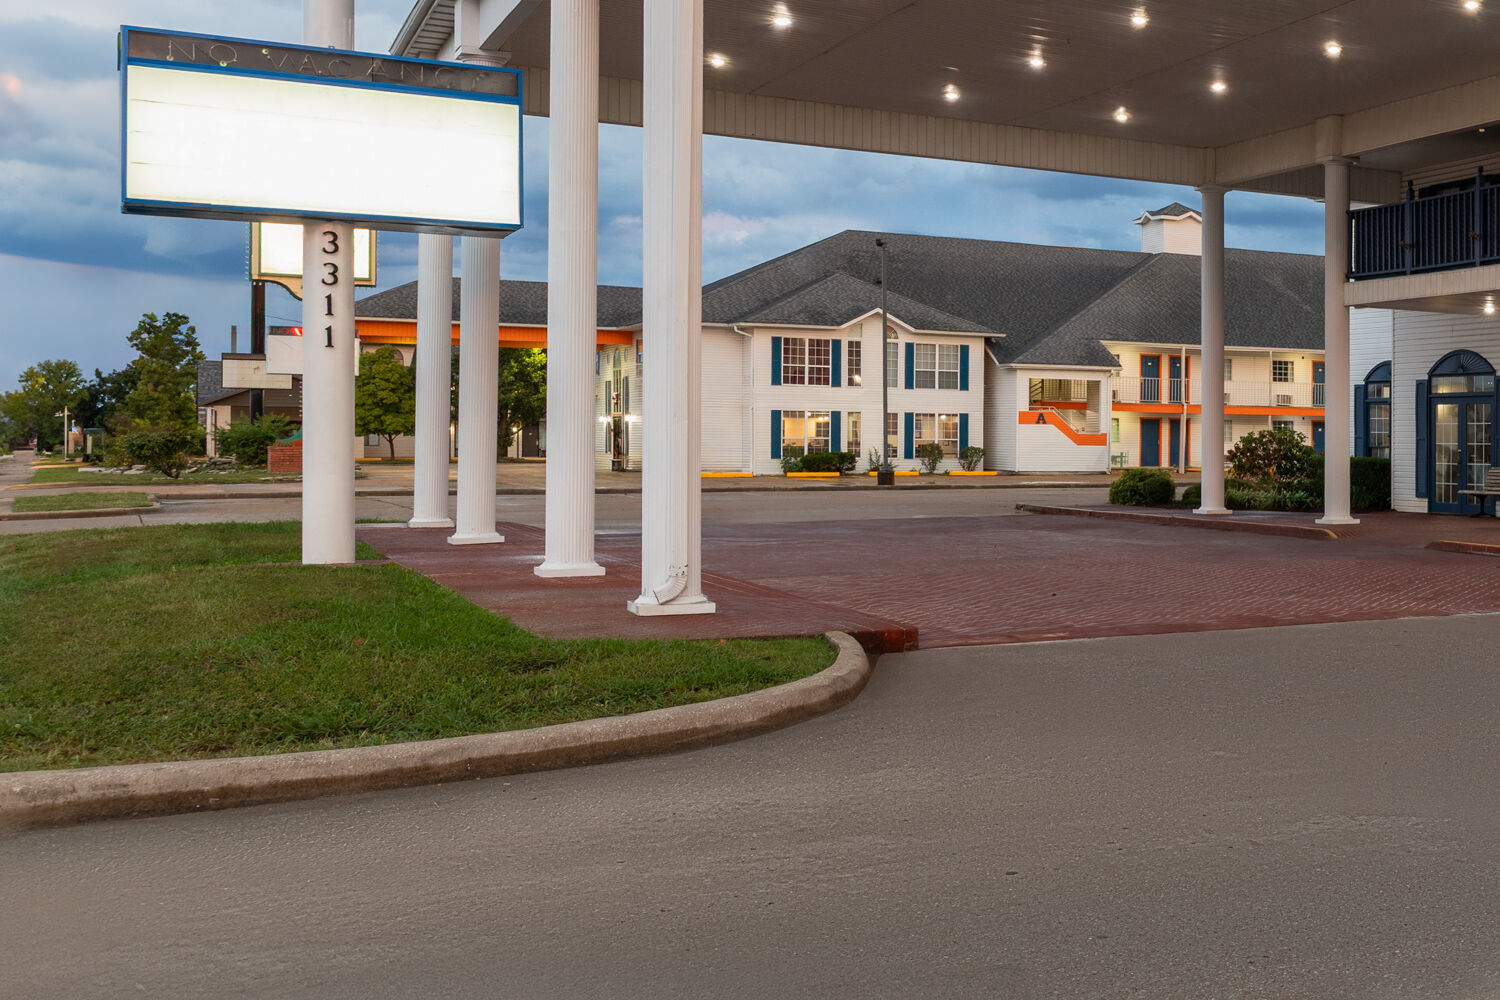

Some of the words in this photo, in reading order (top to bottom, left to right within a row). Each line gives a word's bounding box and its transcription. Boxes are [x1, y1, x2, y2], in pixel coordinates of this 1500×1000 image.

[169, 39, 238, 66] NO
[321, 230, 340, 348] 3311
[1035, 412, 1047, 424] A
